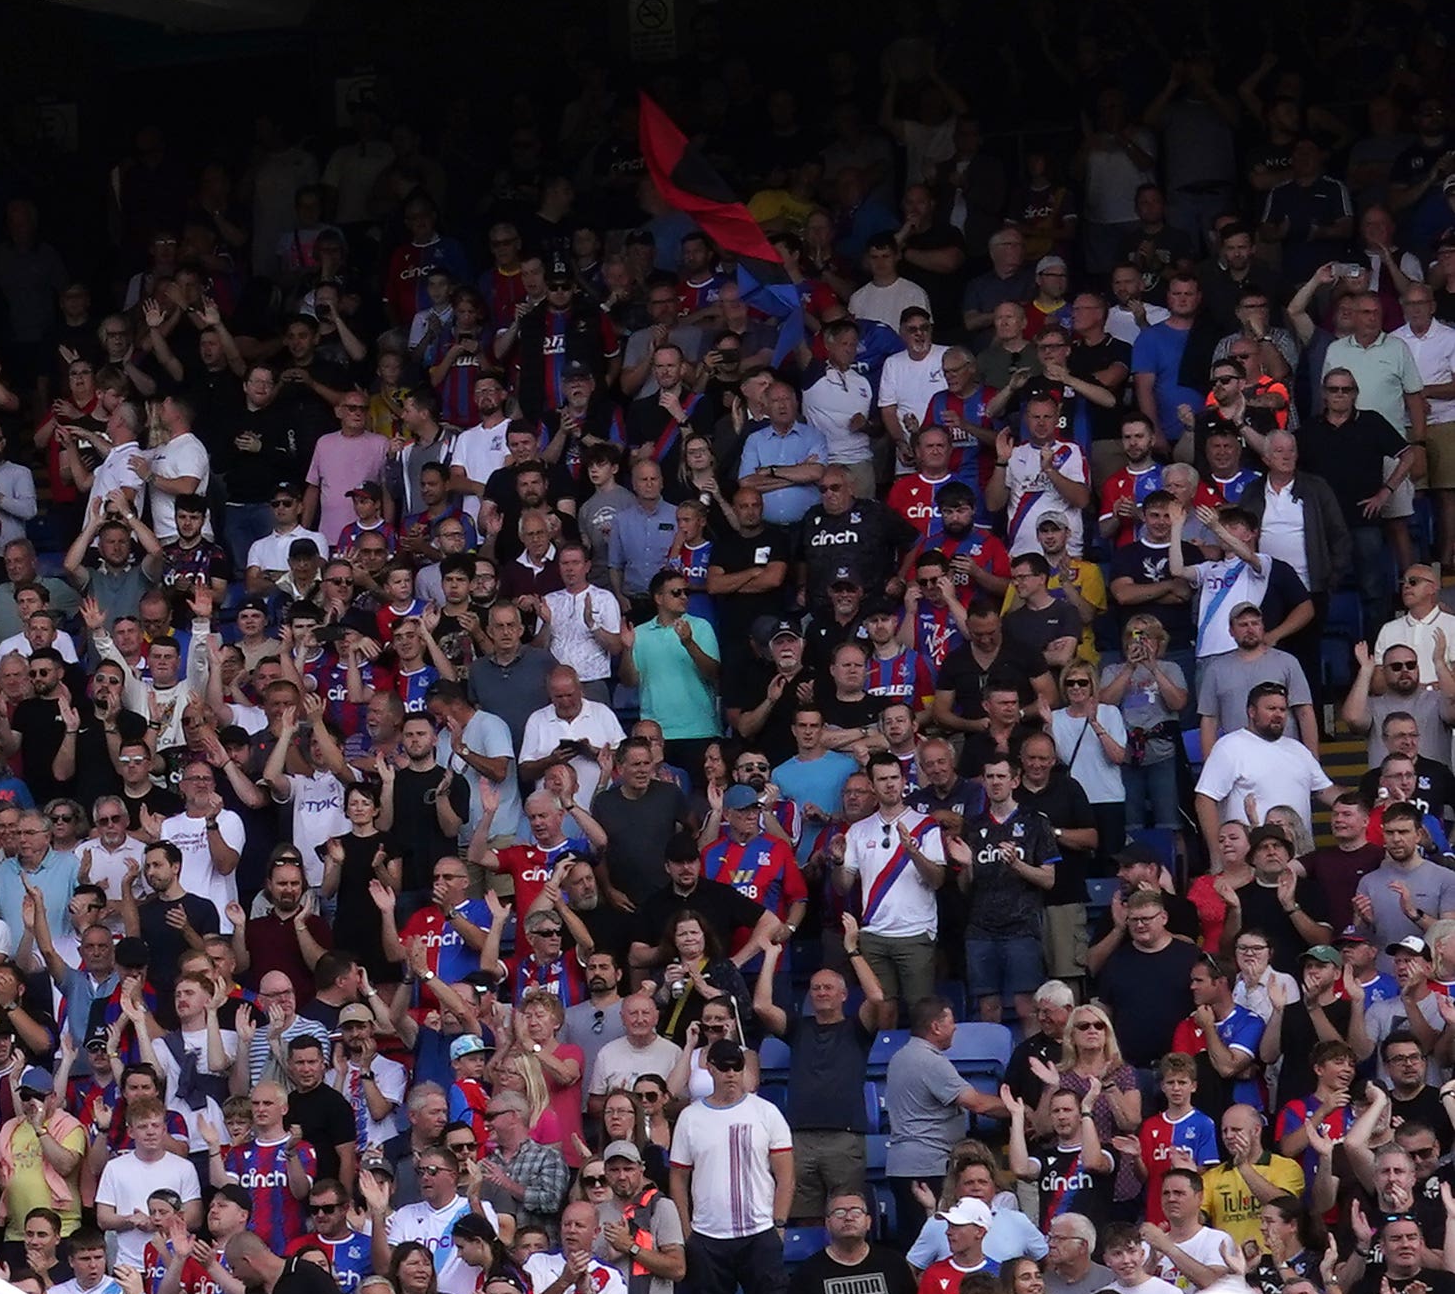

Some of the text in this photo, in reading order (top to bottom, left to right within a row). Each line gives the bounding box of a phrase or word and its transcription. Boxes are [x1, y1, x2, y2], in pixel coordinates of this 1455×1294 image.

[907, 502, 942, 518] cinc
[811, 529, 857, 546] cinch
[305, 799, 338, 812] TDK
[977, 841, 1024, 863] cinh
[241, 1170, 287, 1187] cinch
[1042, 1171, 1093, 1191] cinch
[1220, 1192, 1261, 1214] Tulip
